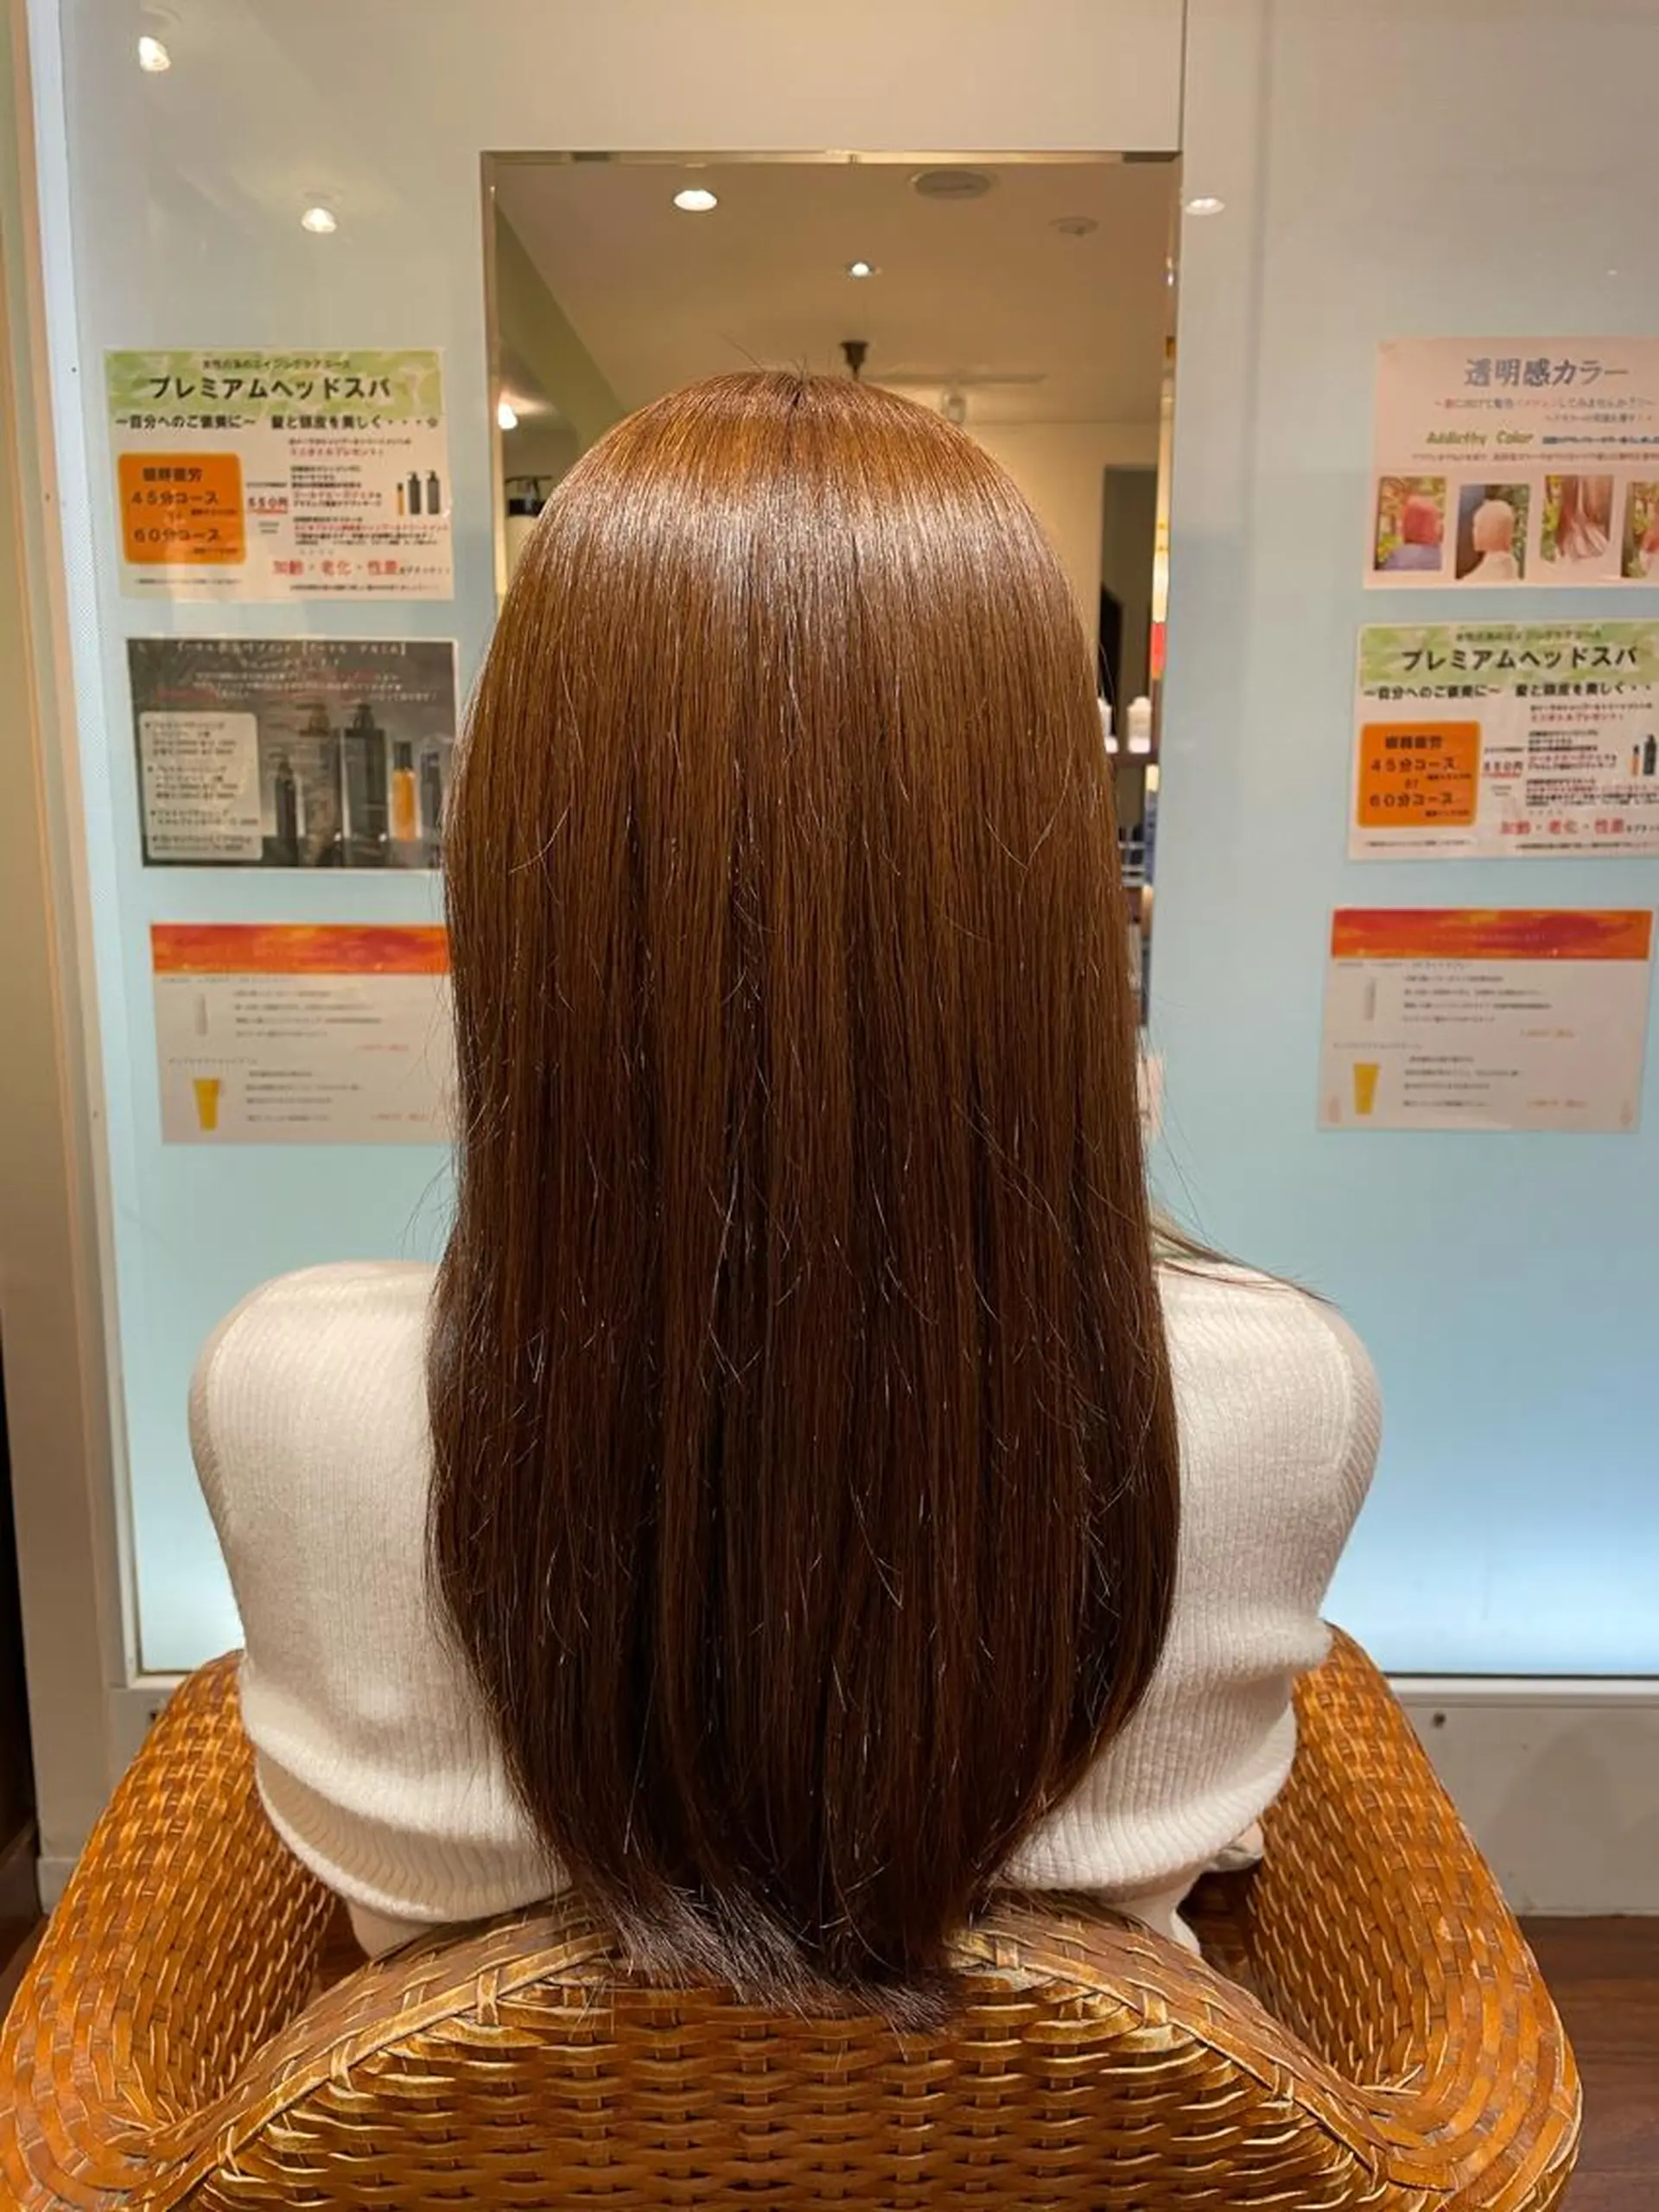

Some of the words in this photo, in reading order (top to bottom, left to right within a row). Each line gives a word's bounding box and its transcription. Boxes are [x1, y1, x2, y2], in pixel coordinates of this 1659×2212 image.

[1465, 358, 1630, 387] 透明感カラー
[149, 377, 391, 400] プレミアムヘッドスパ
[1402, 646, 1637, 671] プレミアムヘッドスパ
